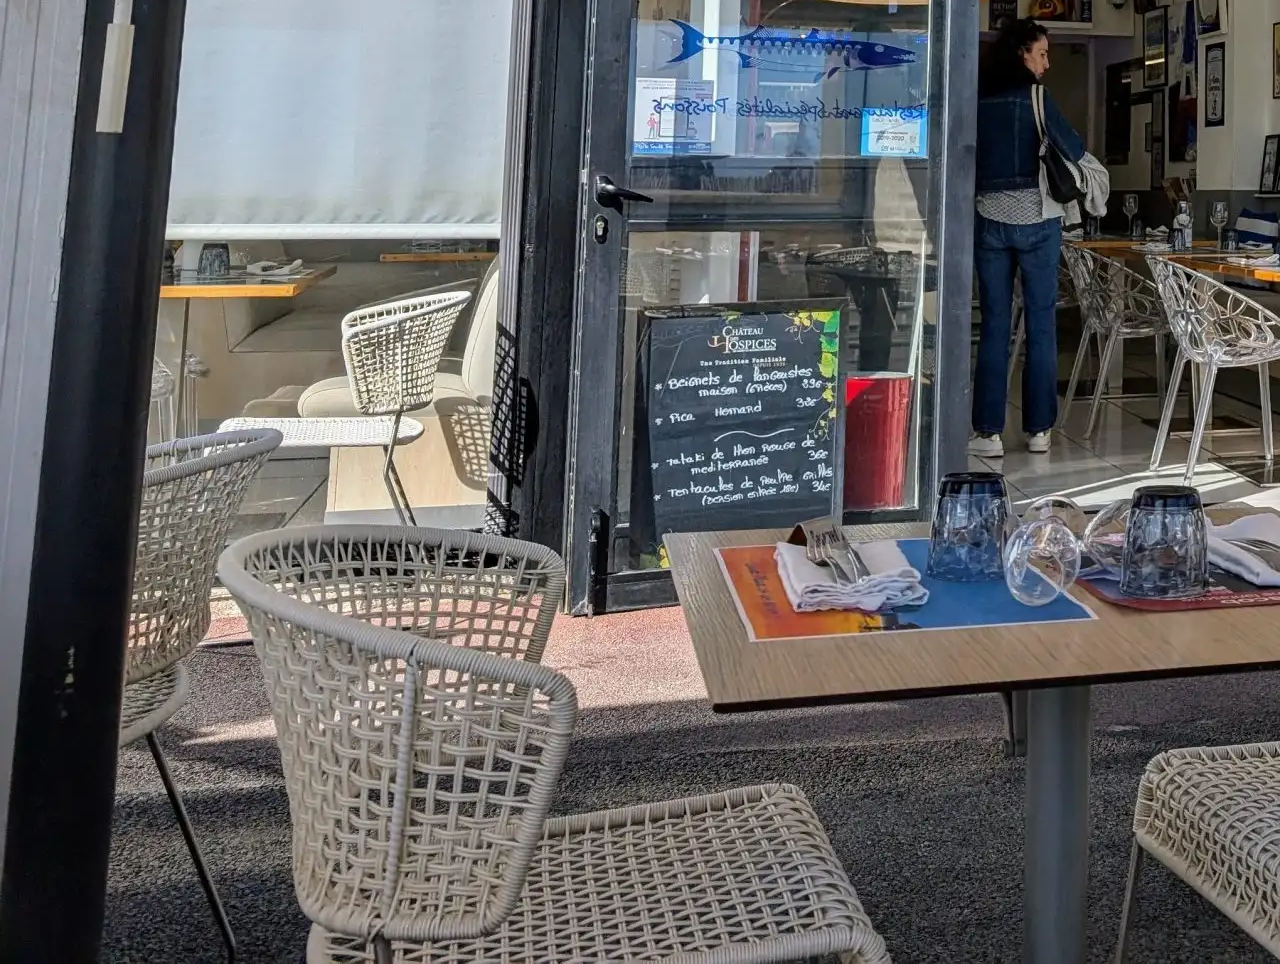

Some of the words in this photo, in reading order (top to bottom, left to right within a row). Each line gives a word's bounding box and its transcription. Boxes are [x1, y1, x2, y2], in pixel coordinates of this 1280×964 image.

[729, 369, 743, 384] de
[711, 447, 724, 460] de
[802, 434, 815, 448] de
